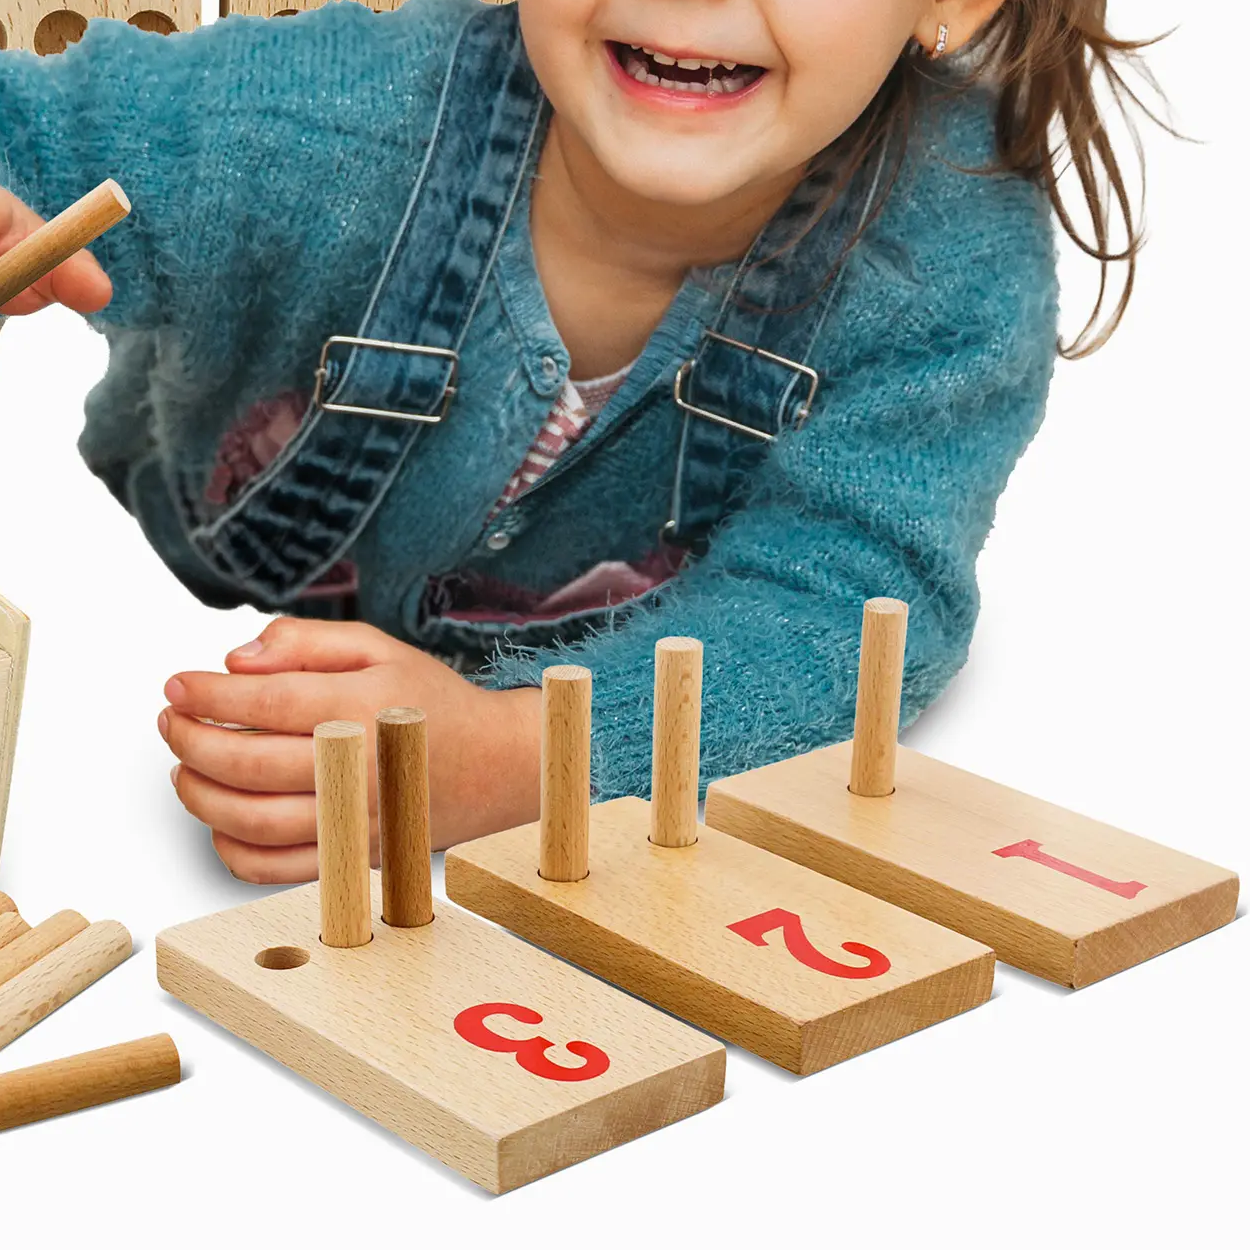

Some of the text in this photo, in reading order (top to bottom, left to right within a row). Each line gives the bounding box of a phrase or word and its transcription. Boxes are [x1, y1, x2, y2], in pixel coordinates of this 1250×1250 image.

[992, 839, 1148, 899] 1
[727, 908, 891, 979] 2
[454, 1003, 610, 1081] 3
